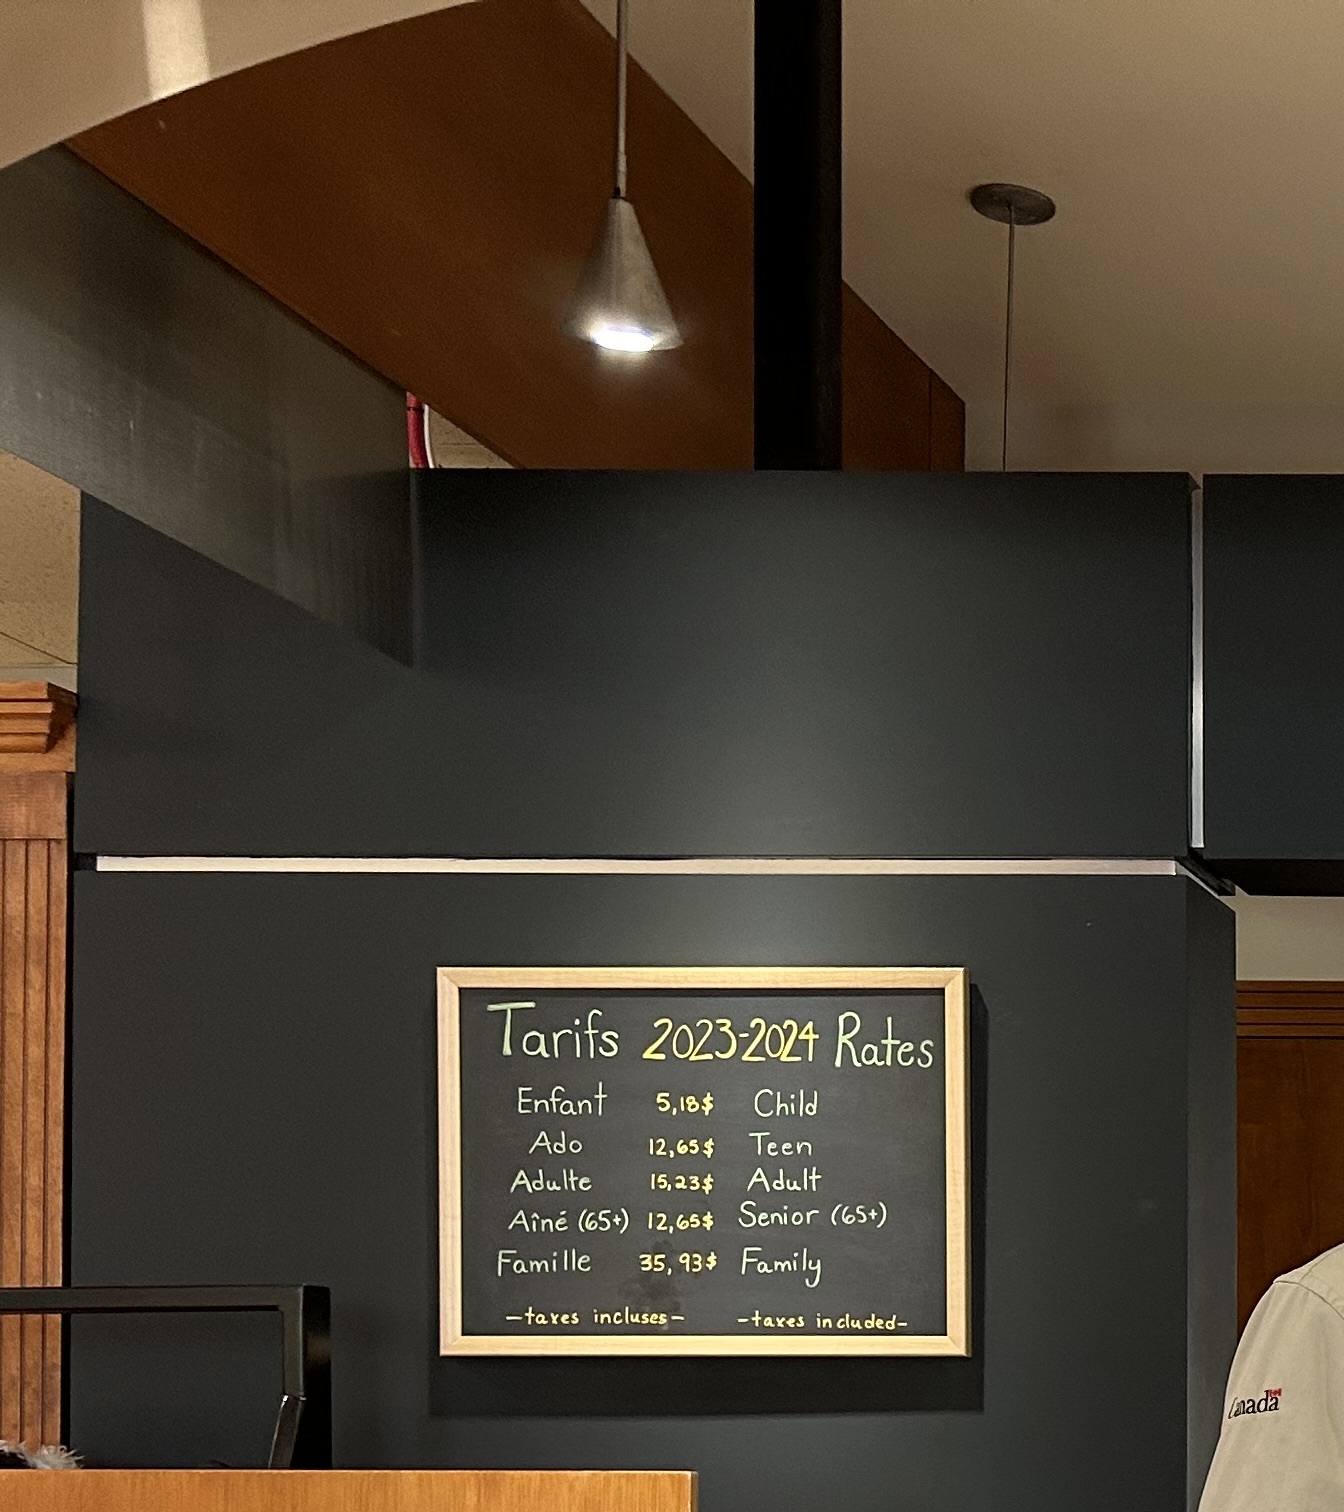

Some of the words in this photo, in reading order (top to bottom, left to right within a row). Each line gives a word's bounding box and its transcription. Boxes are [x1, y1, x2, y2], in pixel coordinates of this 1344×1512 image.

[487, 1002, 619, 1059] Tarifs
[643, 1018, 819, 1061] 2023-2024
[835, 1012, 933, 1068] Rates
[518, 1081, 607, 1116] Enfant
[656, 1092, 713, 1116] 5,18$
[755, 1089, 817, 1117] Child
[529, 1131, 582, 1154] Ado
[650, 1138, 714, 1158] 12,65$
[749, 1132, 811, 1156] Teen
[511, 1169, 592, 1193] Adulte
[651, 1174, 714, 1194] 15,23$
[747, 1167, 822, 1192] Adult
[579, 1209, 628, 1234] (65+)
[648, 1212, 713, 1232] 12,65$
[739, 1202, 819, 1227] Senior
[831, 1202, 886, 1228] (65+)
[498, 1248, 591, 1276] Famille
[742, 1247, 821, 1287] Family
